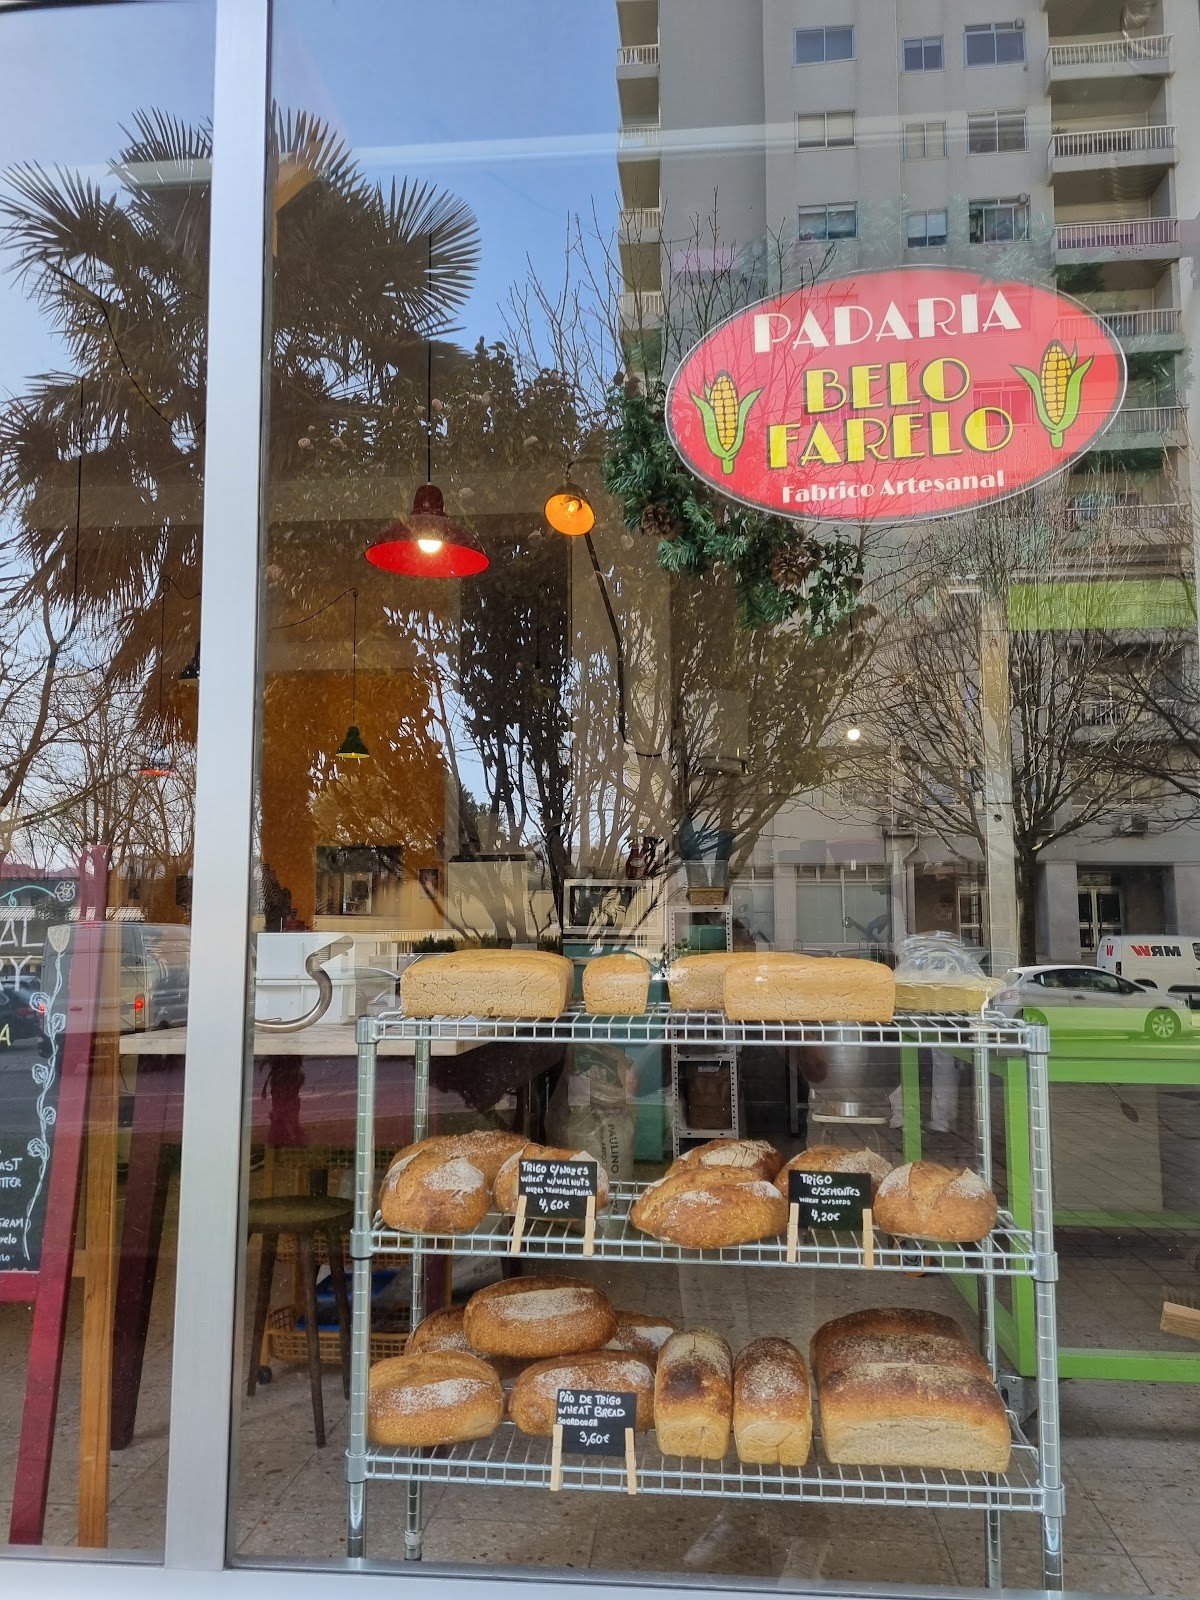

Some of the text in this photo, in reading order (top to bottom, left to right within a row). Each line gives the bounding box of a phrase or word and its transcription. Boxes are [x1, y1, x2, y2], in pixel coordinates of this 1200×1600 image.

[754, 290, 1022, 354] PADARIA
[805, 357, 970, 414] BELO
[768, 406, 1014, 469] FARELO
[782, 470, 1005, 504] Fabrico Artesanal
[608, 1124, 620, 1175] PAULINO
[538, 1198, 570, 1213] 4,60€
[811, 1208, 841, 1223] 4,20€
[558, 1390, 575, 1404] PÃO
[579, 1394, 593, 1405] DE
[557, 1405, 626, 1418] WHEAT BREAD
[579, 1430, 611, 1447] 3,60€
